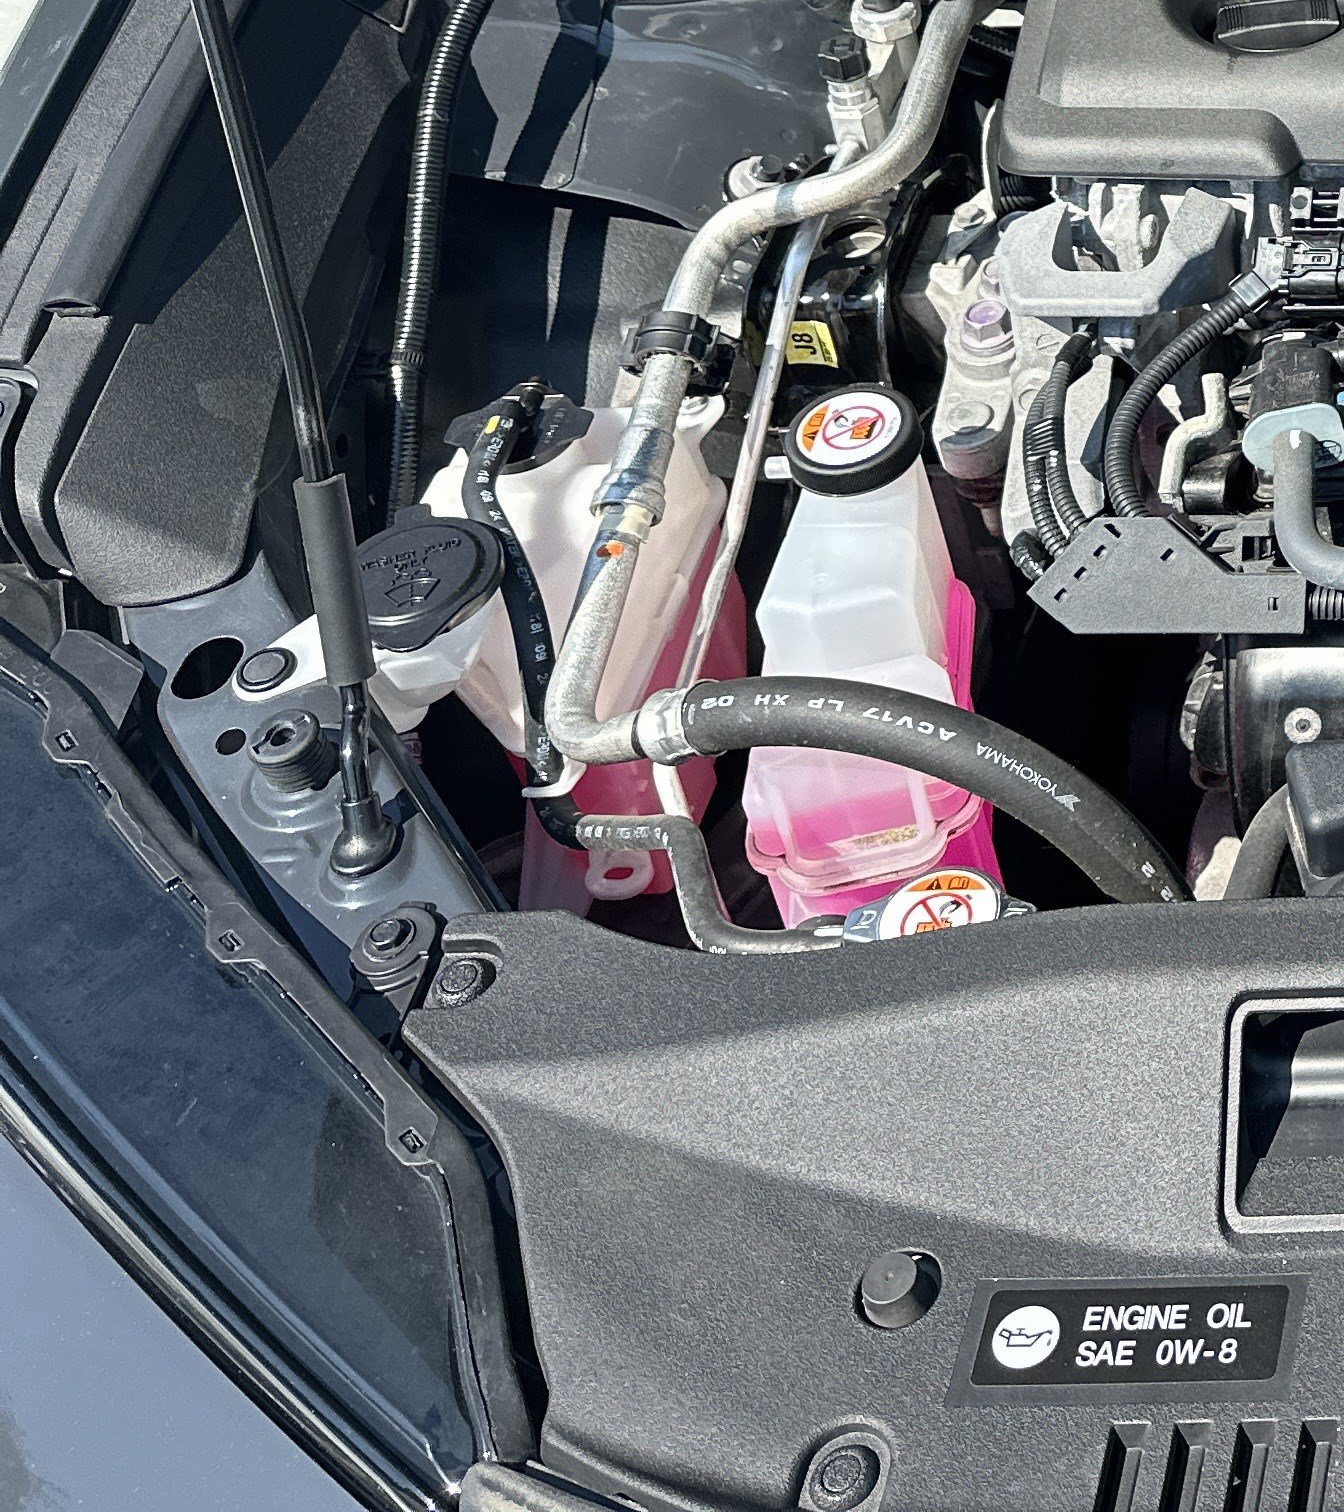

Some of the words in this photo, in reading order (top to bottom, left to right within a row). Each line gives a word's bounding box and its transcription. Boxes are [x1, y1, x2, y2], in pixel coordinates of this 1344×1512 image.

[792, 333, 817, 355] J8
[754, 694, 790, 706] XH
[808, 698, 845, 712] LP
[862, 707, 958, 741] ACV17
[976, 741, 1058, 798] YOKOHAMA
[1082, 1304, 1190, 1331] ENGINE
[1206, 1303, 1252, 1329] OIL
[1075, 1340, 1136, 1367] SAE
[1156, 1338, 1238, 1366] 0W-8
